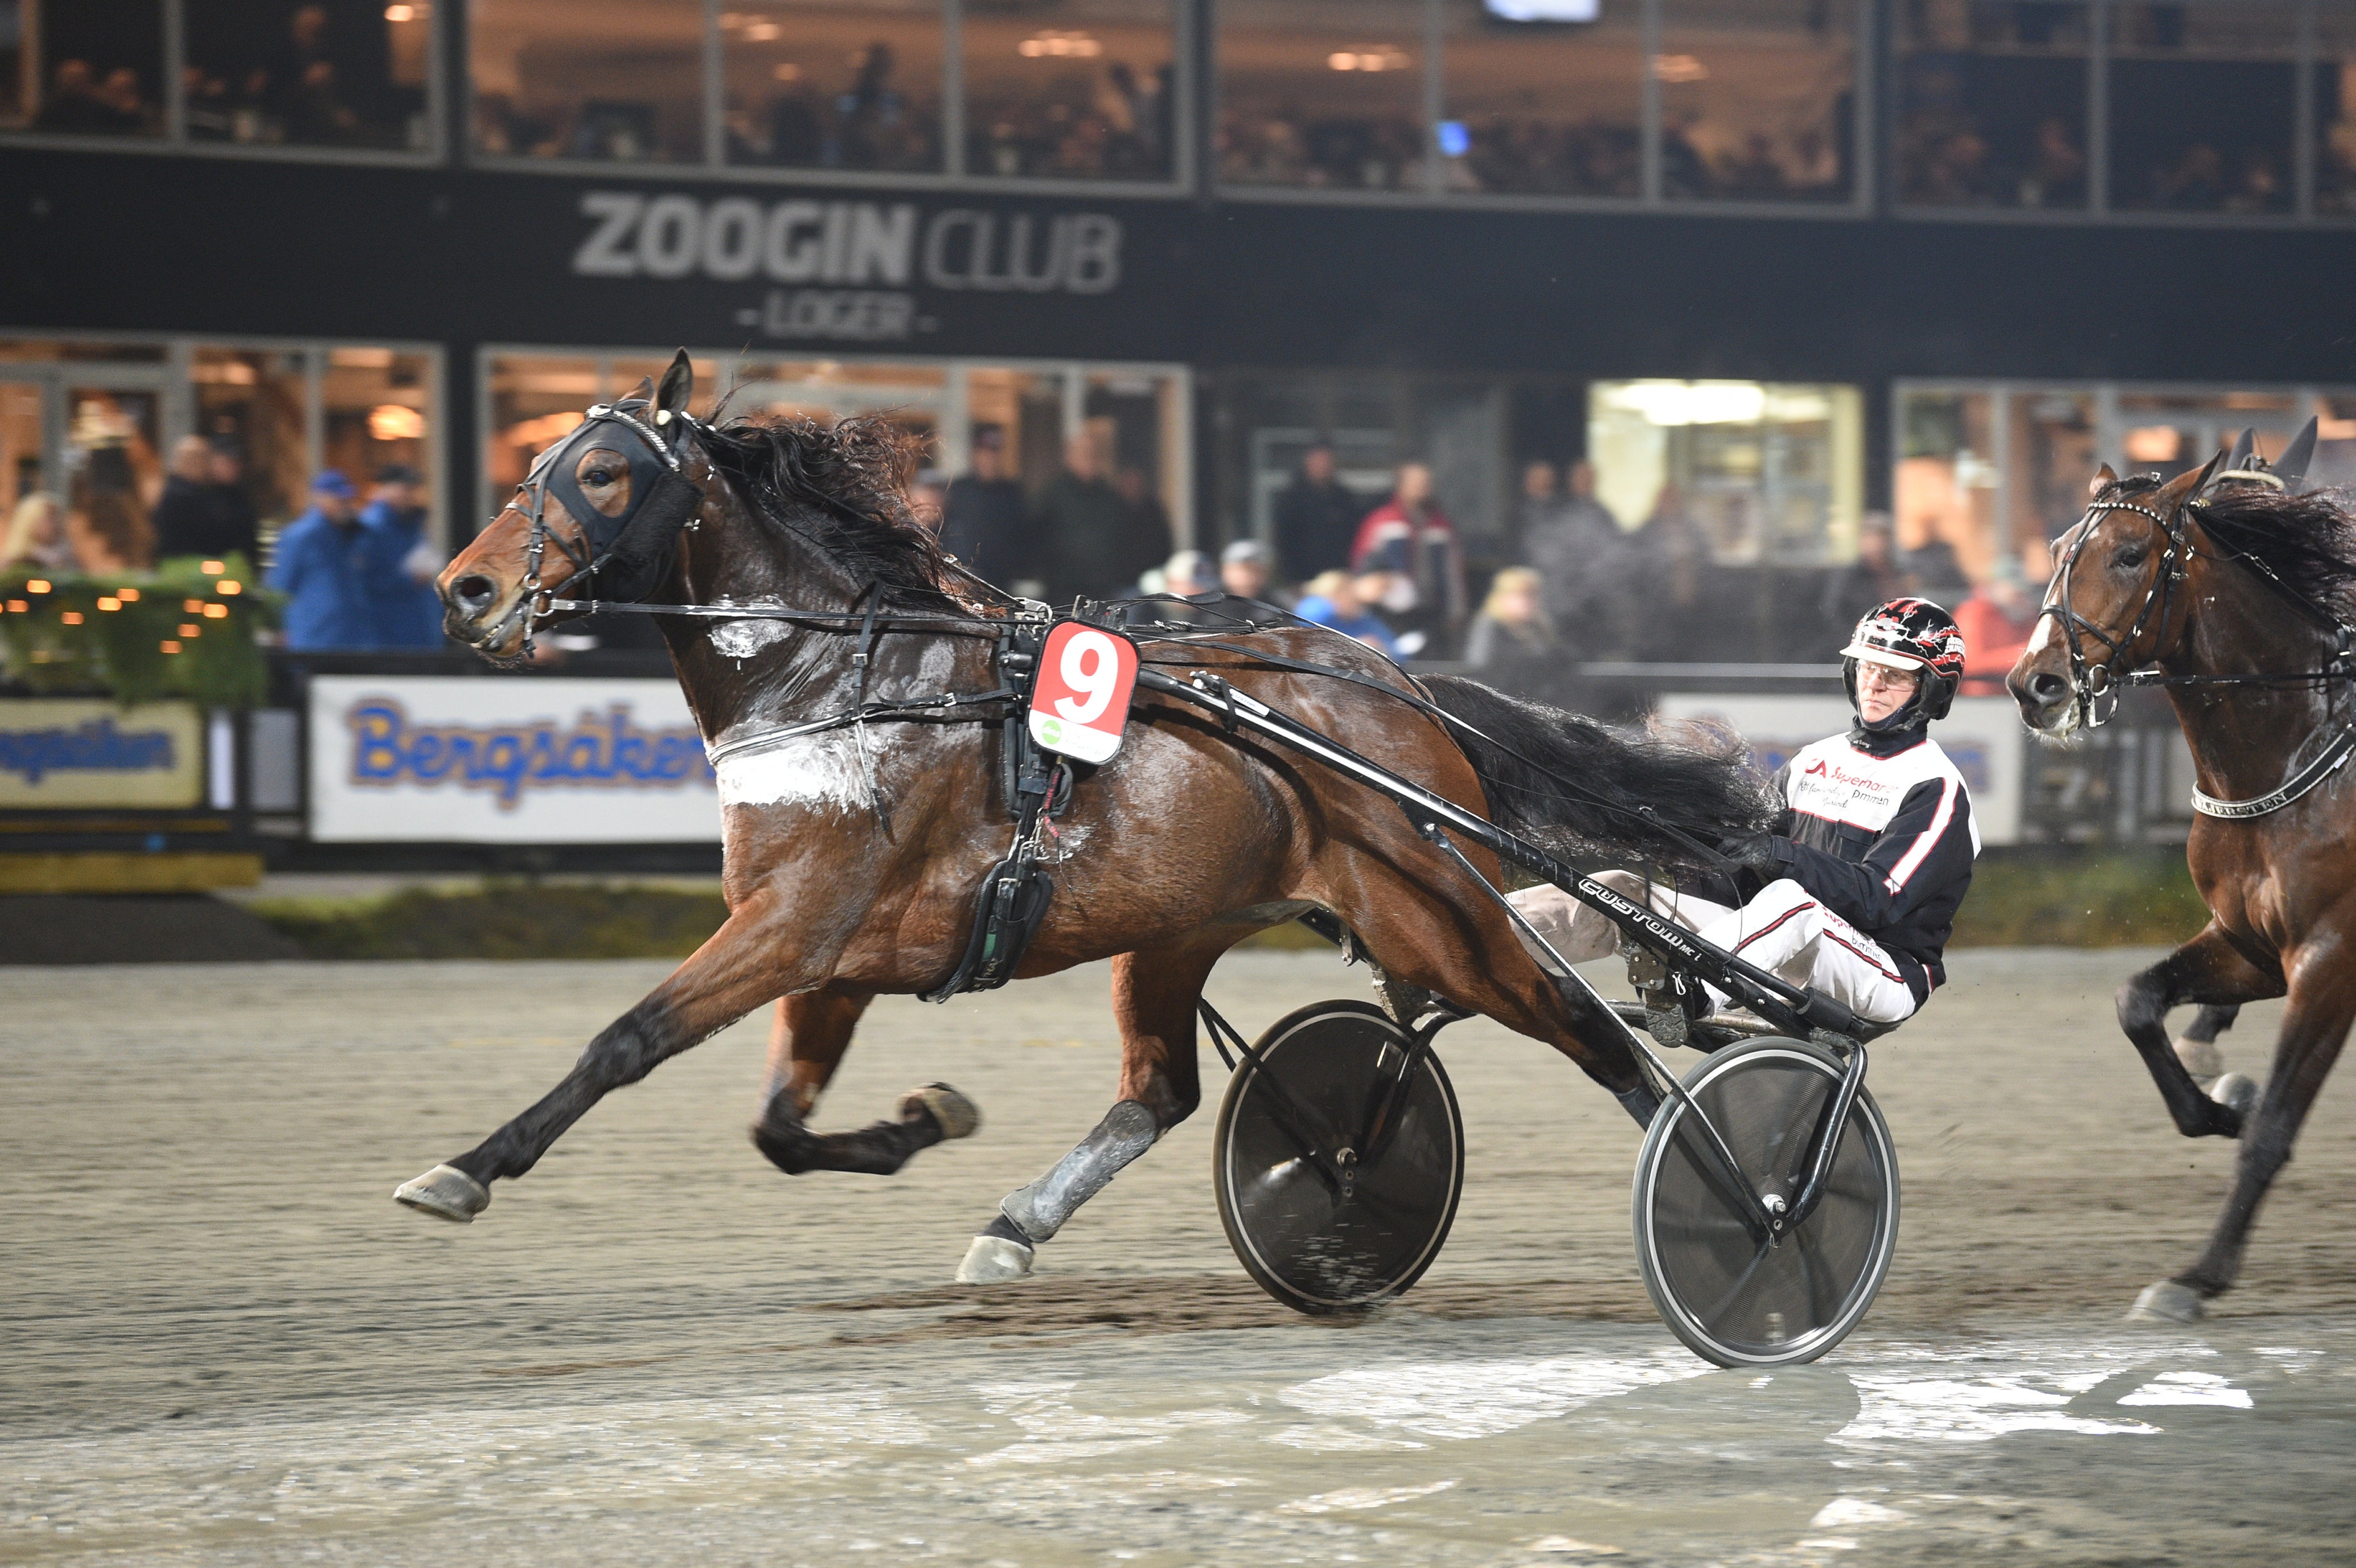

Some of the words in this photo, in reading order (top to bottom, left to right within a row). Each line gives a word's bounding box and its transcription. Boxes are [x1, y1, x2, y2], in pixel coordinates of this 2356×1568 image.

[575, 191, 914, 284] ZOOGIN
[924, 209, 1122, 293] CLUB
[1054, 631, 1118, 724] 9
[1579, 878, 1683, 947] CUSTOM
